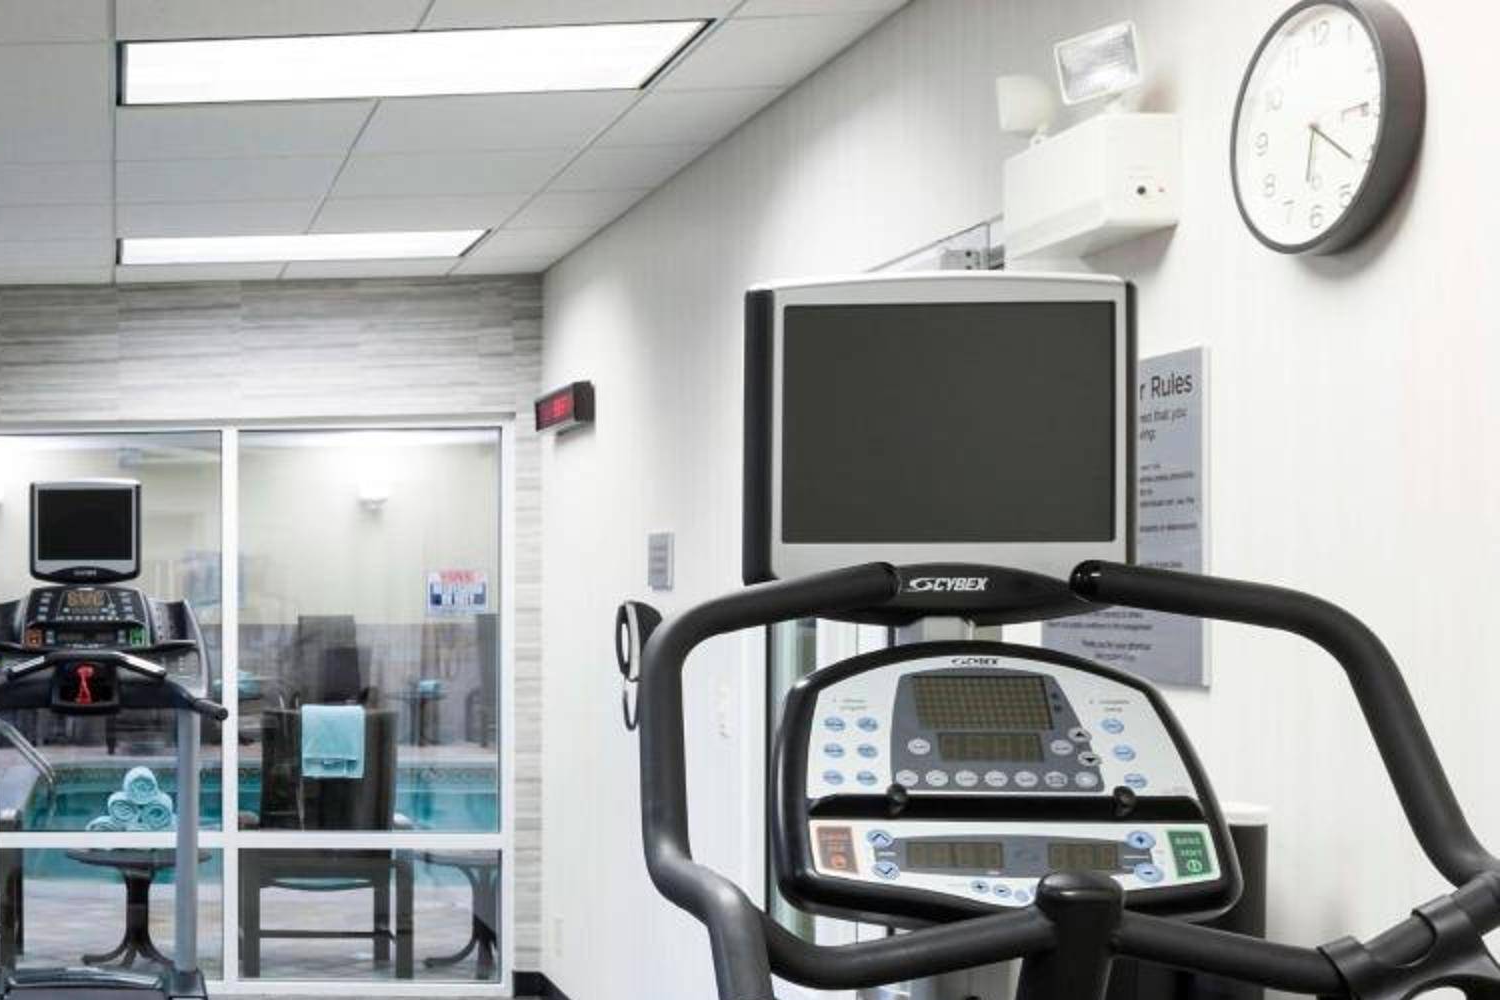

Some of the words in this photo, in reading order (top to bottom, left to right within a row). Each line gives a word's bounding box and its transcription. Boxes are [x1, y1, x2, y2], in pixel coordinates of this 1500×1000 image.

[1312, 20, 1331, 47] 12
[1254, 131, 1269, 157] 9
[1262, 173, 1276, 198] 8
[1283, 199, 1295, 225] 7
[1309, 204, 1324, 229] 6
[1151, 371, 1193, 401] Rules
[932, 577, 989, 591] CYBEX
